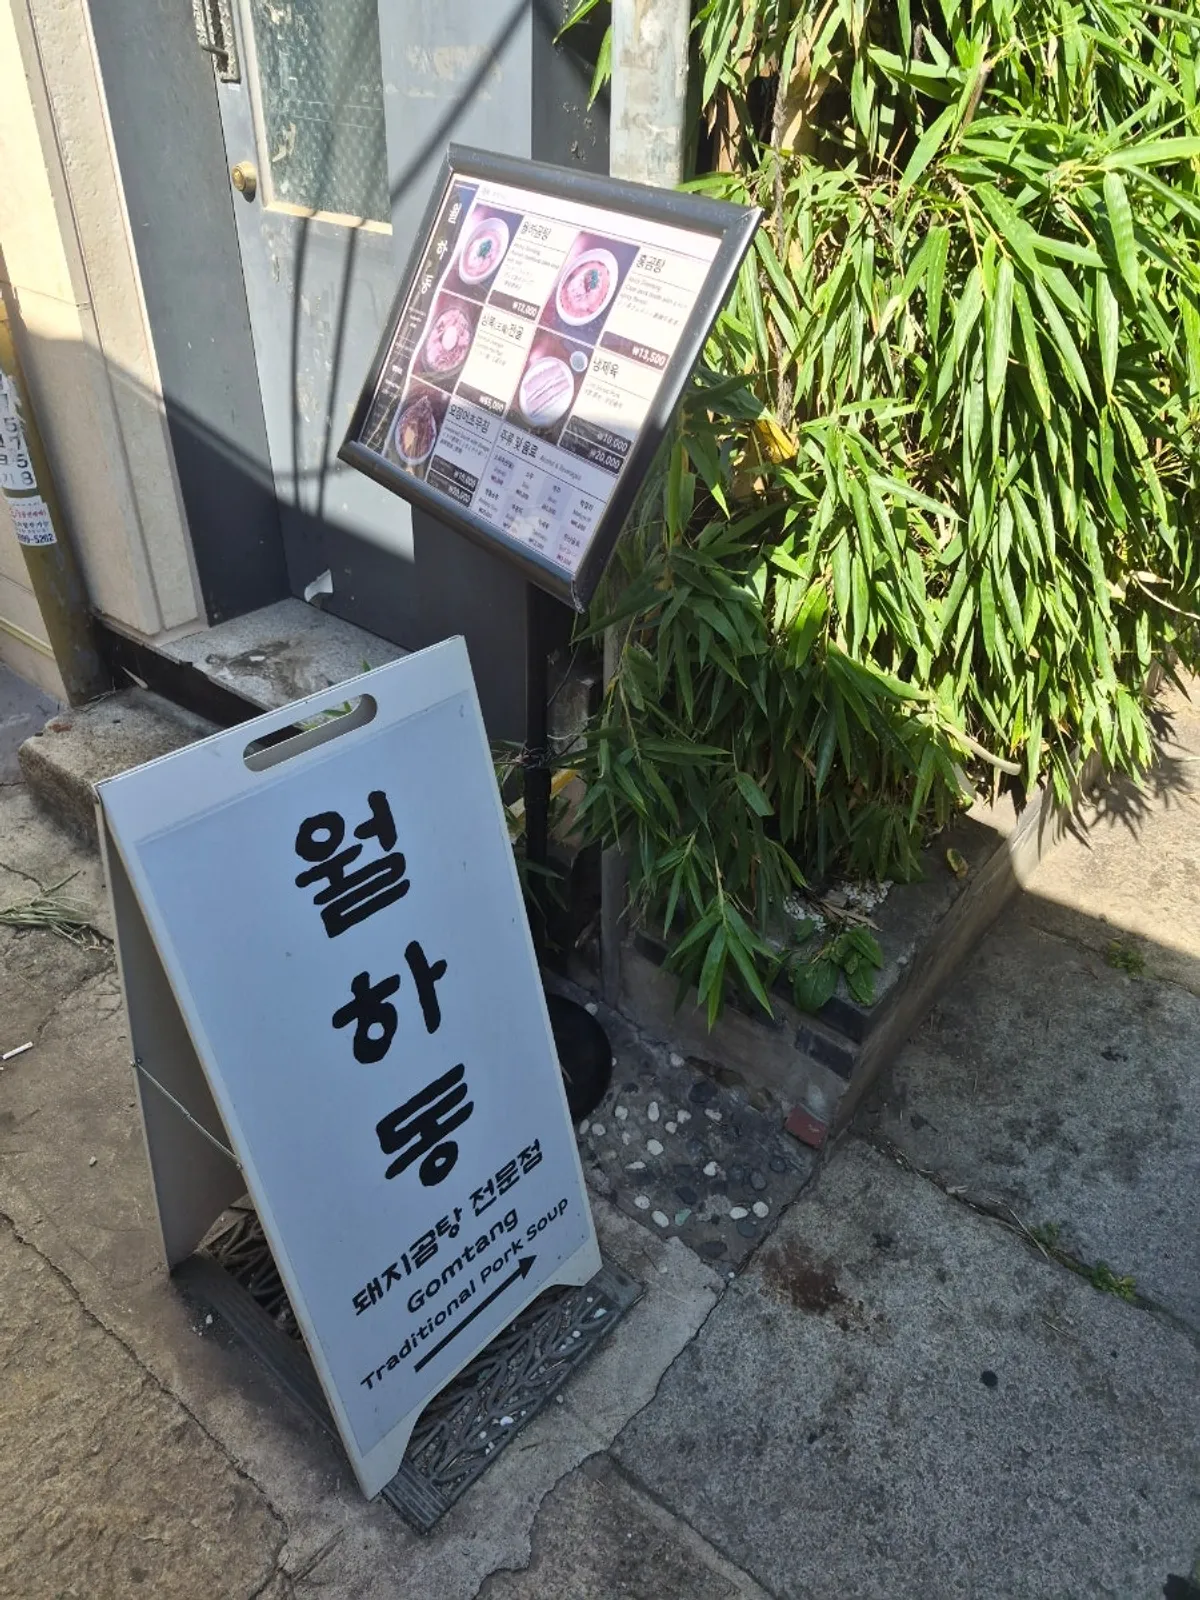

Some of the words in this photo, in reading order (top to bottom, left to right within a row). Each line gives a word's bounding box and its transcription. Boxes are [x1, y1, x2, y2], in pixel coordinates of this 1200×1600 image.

[631, 343, 667, 367] ₩13,500
[295, 790, 474, 1187] 월하동
[352, 1206, 463, 1316] 돼지곰탕
[469, 1138, 543, 1217] 전문점
[360, 1280, 476, 1390] Traditional
[480, 1239, 523, 1284] Pork
[527, 1198, 569, 1242] Soup
[407, 1208, 519, 1313] Gomtang
